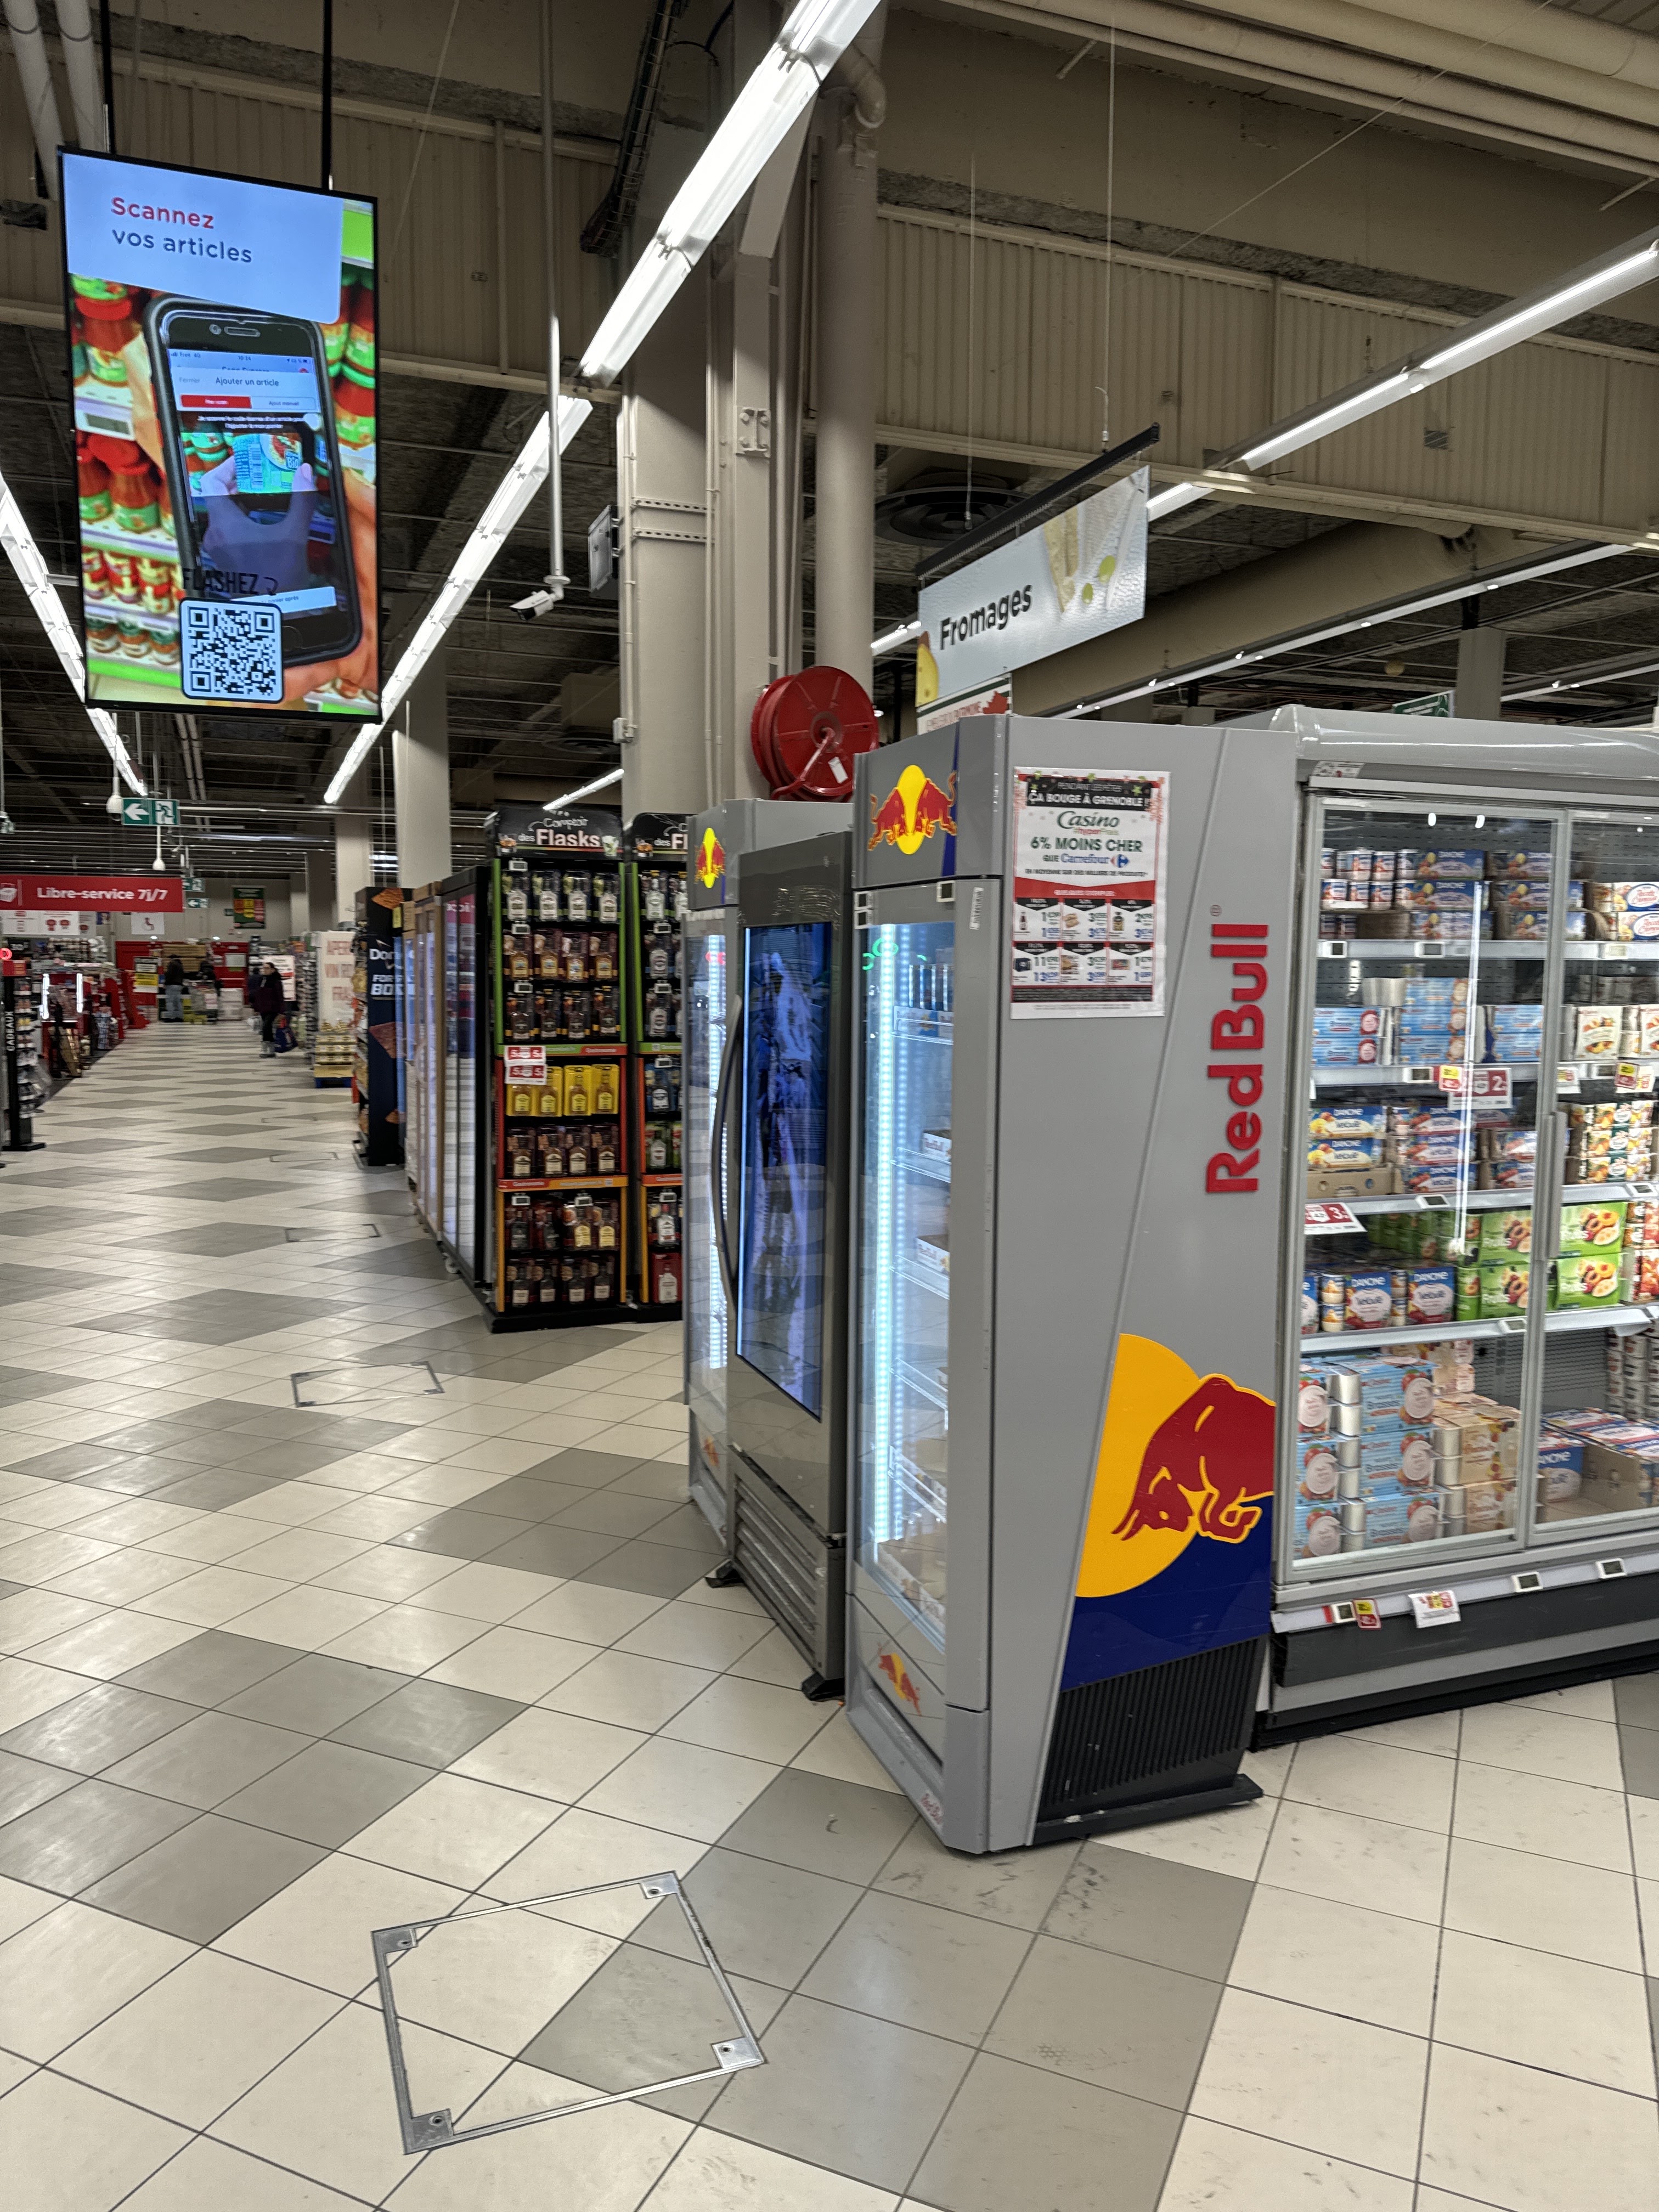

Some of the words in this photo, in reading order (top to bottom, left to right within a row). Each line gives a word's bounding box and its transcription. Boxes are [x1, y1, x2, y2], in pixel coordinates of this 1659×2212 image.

[111, 197, 215, 229] Scannez
[111, 229, 155, 249] vos
[163, 236, 253, 263] articles
[215, 377, 243, 385] Ajouter
[256, 379, 279, 387] article
[182, 567, 260, 595] FLASHEZ
[939, 584, 1033, 650] Fromages
[1046, 793, 1082, 804] BOUGE
[1092, 795, 1143, 806] GRENOBLE
[1057, 810, 1120, 829] Casino
[518, 833, 535, 842] des
[535, 828, 601, 847] Flasks
[654, 837, 671, 847] des
[672, 833, 688, 849] Fl
[1030, 836, 1052, 849] 6%
[1055, 837, 1102, 851] MOINS
[1105, 839, 1143, 852] CHER
[1060, 853, 1111, 864] Carrefour
[37, 887, 135, 900] Libre-service
[137, 889, 168, 902] 7j/7
[1210, 923, 1269, 1050] Bull
[4, 1011, 16, 1052] CADEAUX
[1206, 1064, 1264, 1193] Red
[1351, 1276, 1386, 1288] DANONE
[1414, 1271, 1449, 1282] DANONE
